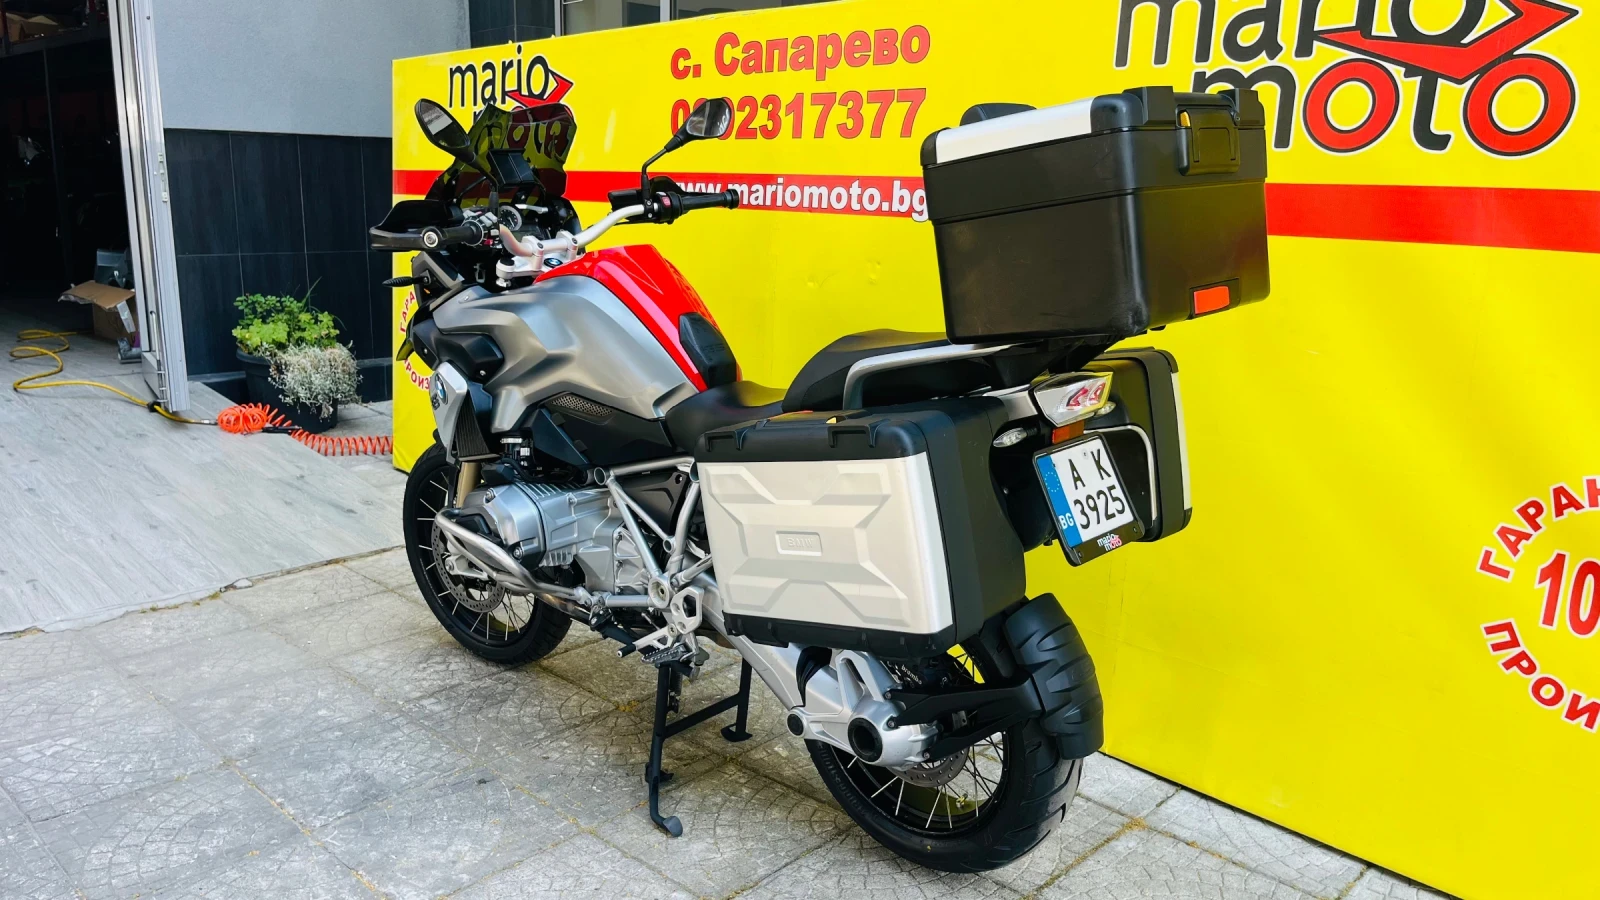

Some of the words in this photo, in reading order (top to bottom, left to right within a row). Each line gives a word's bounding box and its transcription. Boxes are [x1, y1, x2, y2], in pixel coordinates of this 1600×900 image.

[449, 44, 549, 108] mario
[671, 48, 702, 80] с.
[714, 25, 931, 81] Сапарево
[671, 88, 927, 140] 02317377
[1193, 64, 1577, 156] moto
[404, 360, 430, 390] РОИЗ
[1068, 458, 1086, 490] A
[1091, 448, 1112, 481] K
[1058, 513, 1075, 530] BG
[1073, 484, 1126, 530] 3925
[787, 537, 814, 549] BMW
